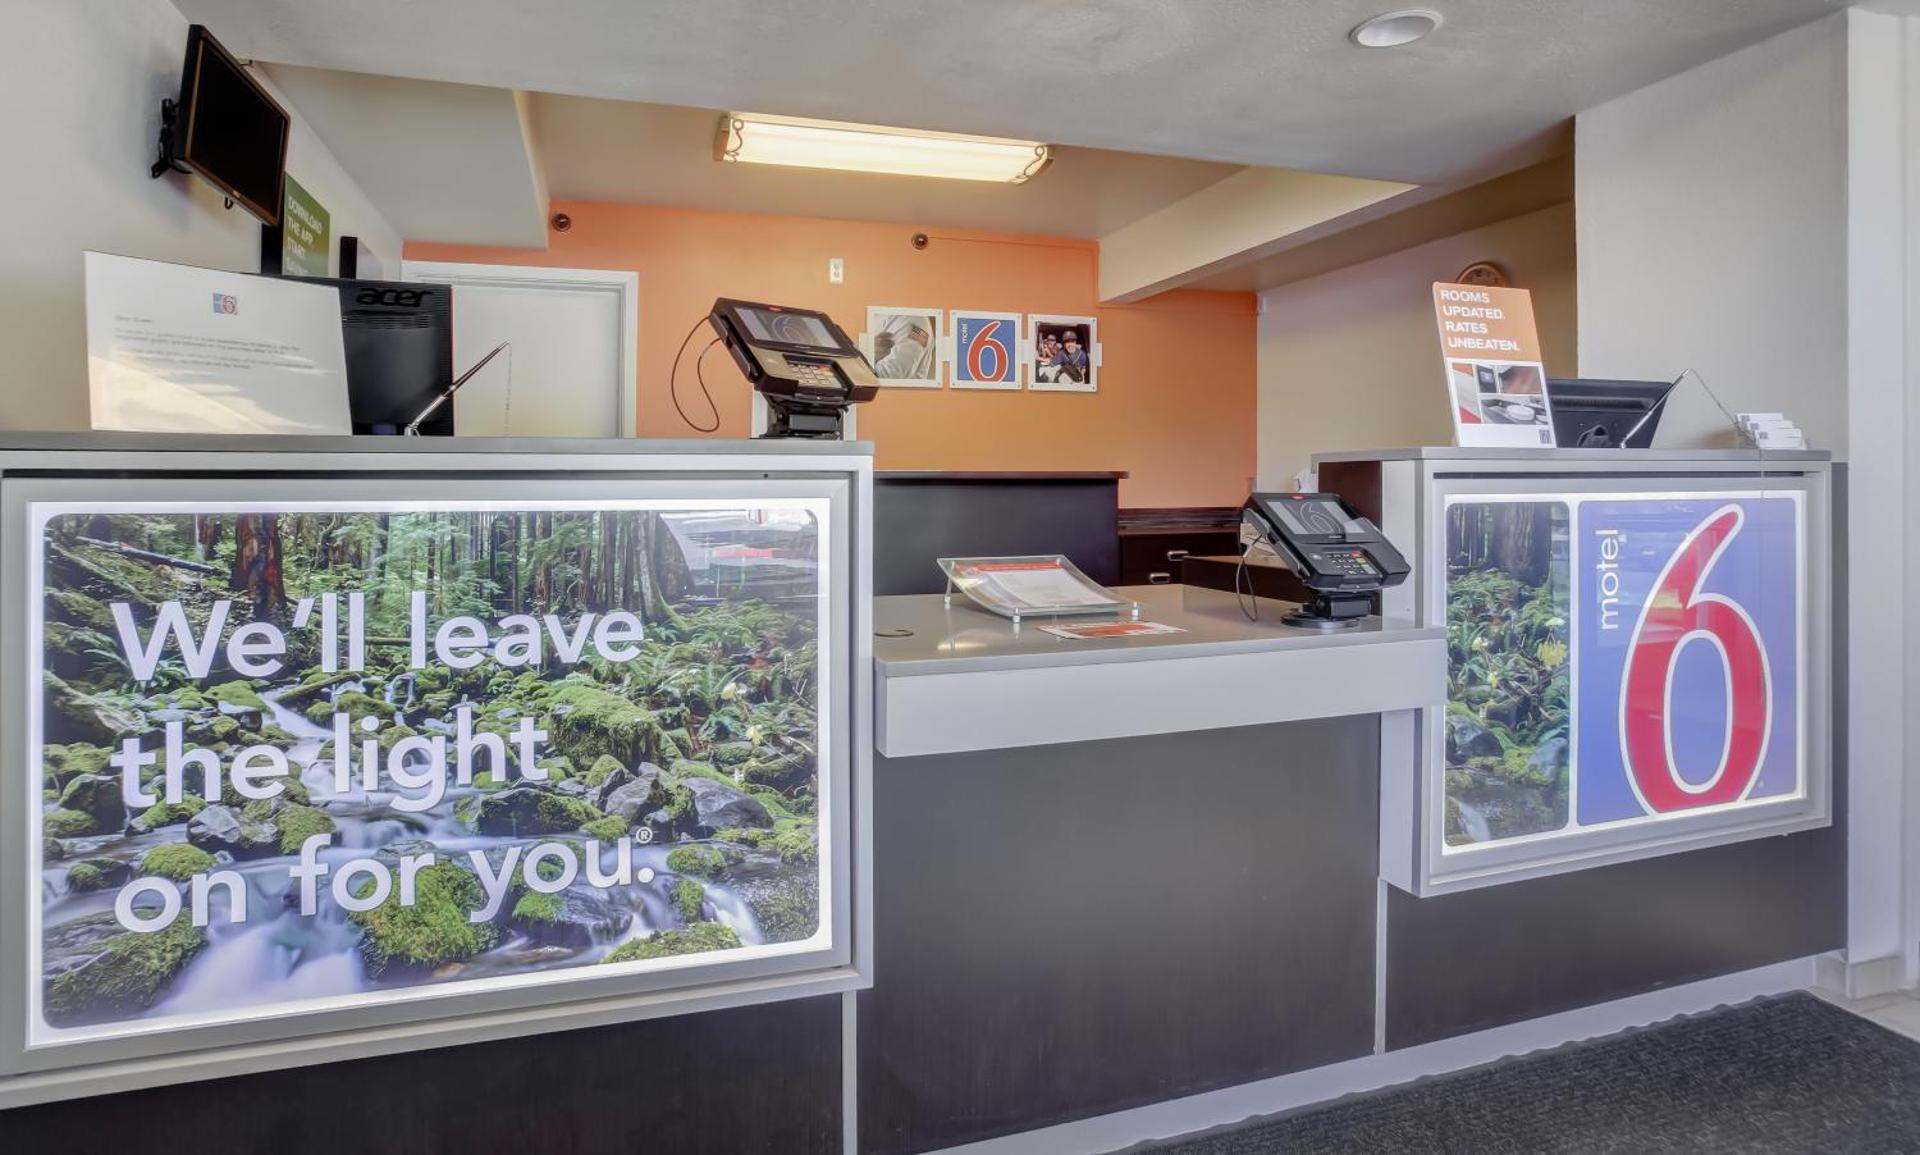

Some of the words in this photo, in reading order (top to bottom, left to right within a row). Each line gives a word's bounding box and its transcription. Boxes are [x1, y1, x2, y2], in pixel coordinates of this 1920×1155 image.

[356, 287, 433, 308] acer
[1440, 288, 1490, 303] ROOMS
[1442, 306, 1505, 320] UPDATED.
[1445, 321, 1488, 334] RATES
[967, 320, 1009, 384] 6
[1448, 336, 1520, 351] UNBEATEN.
[1595, 529, 1619, 630] motel
[411, 590, 644, 670] leave
[1618, 504, 1773, 817] 6
[110, 721, 287, 809] the
[334, 706, 549, 812] light
[115, 860, 248, 934] on
[290, 833, 436, 916] for
